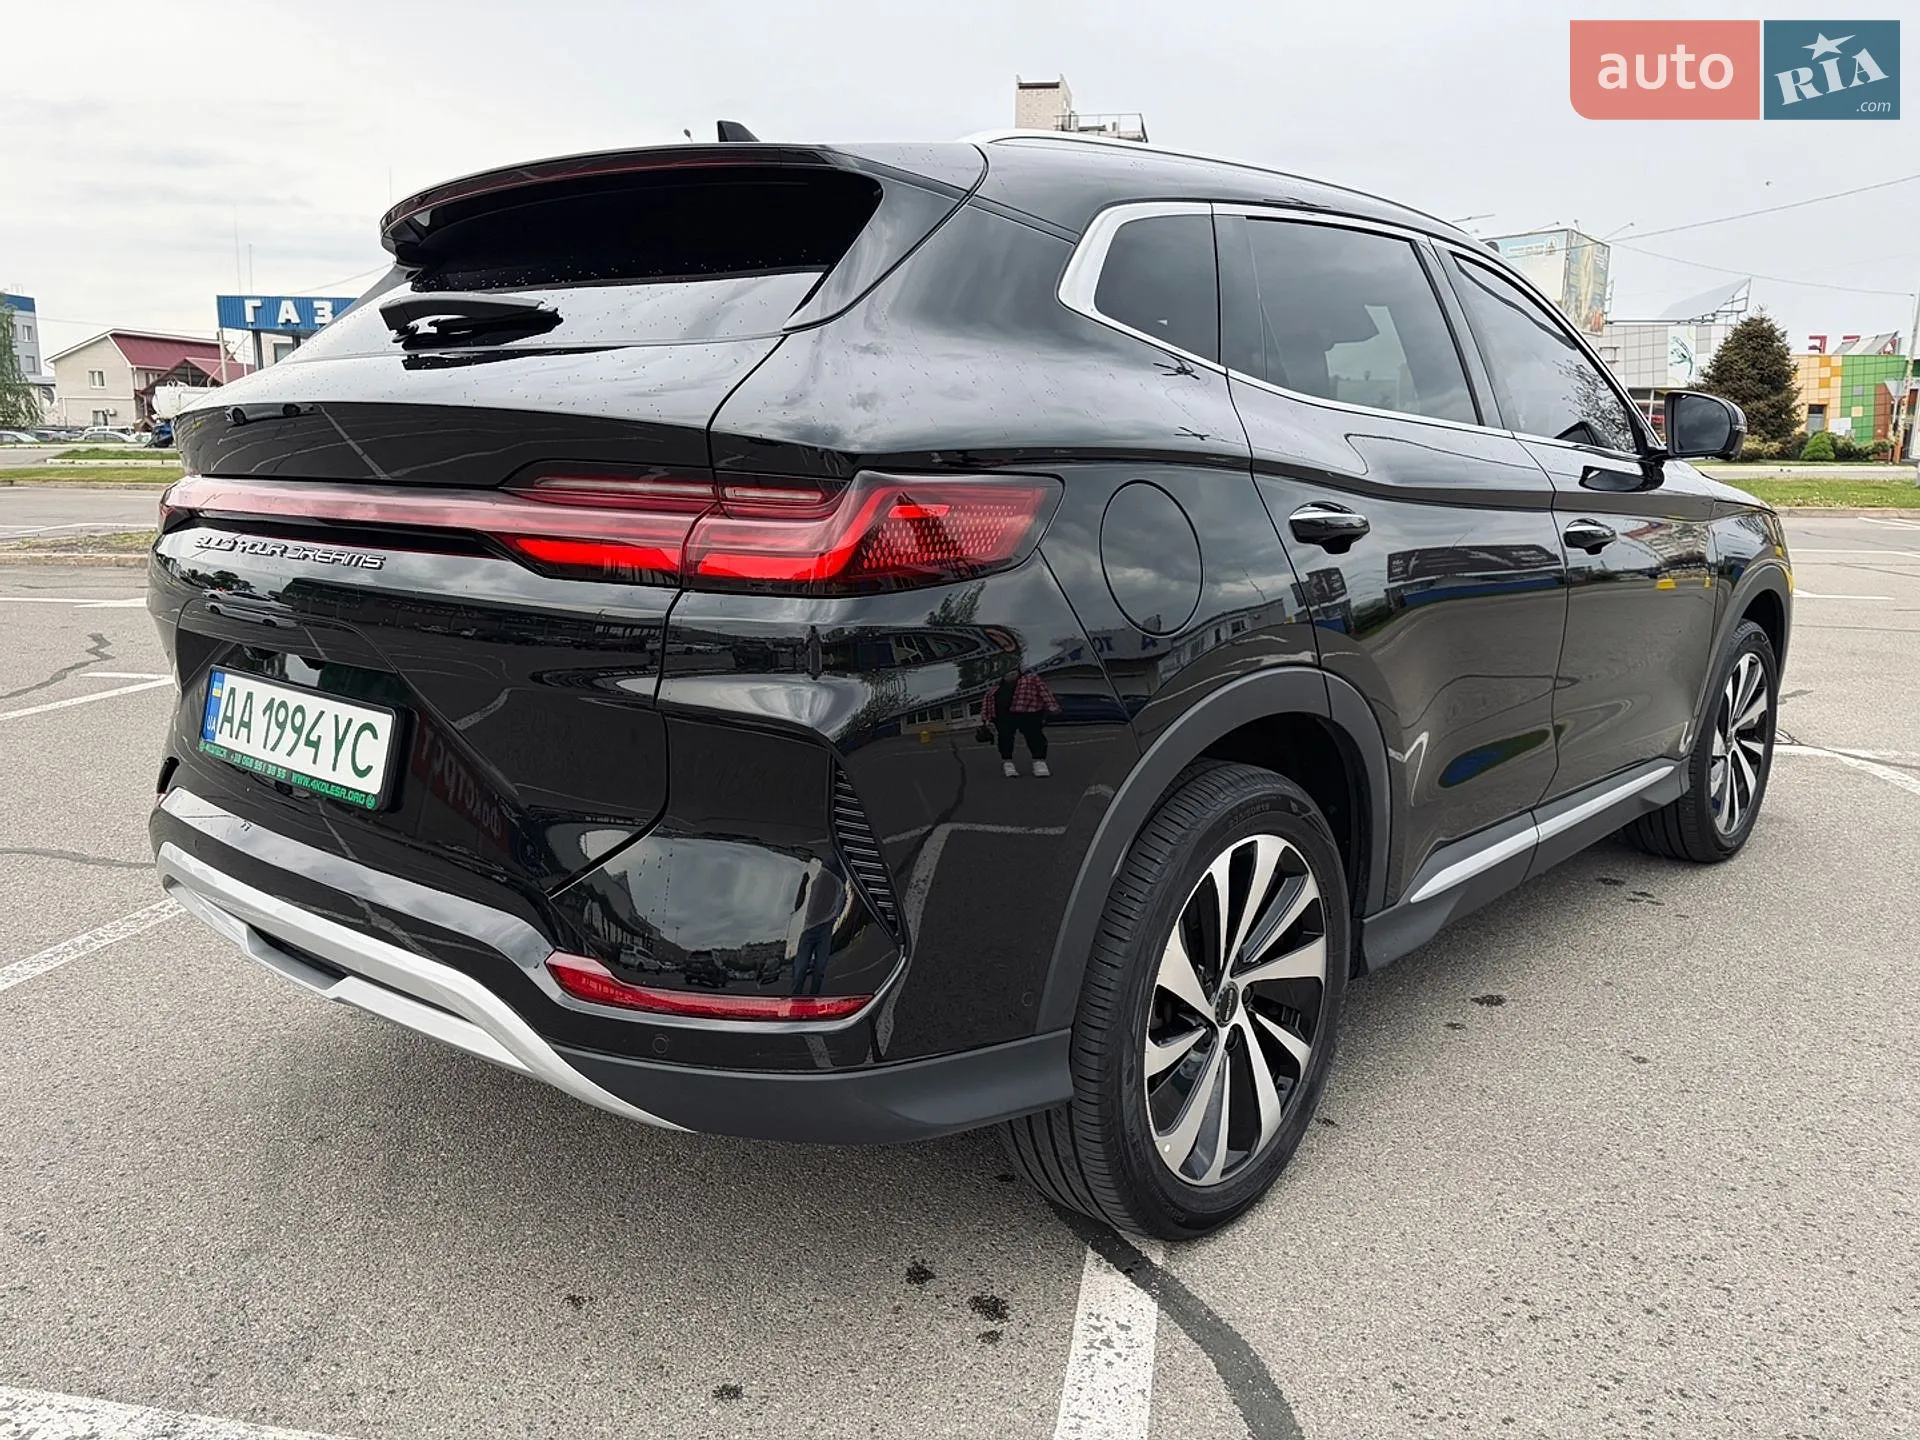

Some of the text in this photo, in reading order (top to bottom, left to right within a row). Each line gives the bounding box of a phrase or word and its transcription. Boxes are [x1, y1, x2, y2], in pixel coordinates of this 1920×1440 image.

[244, 299, 334, 324] ГАЗ
[238, 541, 289, 558] YOUR
[287, 546, 386, 571] DREAMS
[219, 687, 254, 744] AA
[262, 697, 325, 765] 1994
[332, 714, 379, 778] YC
